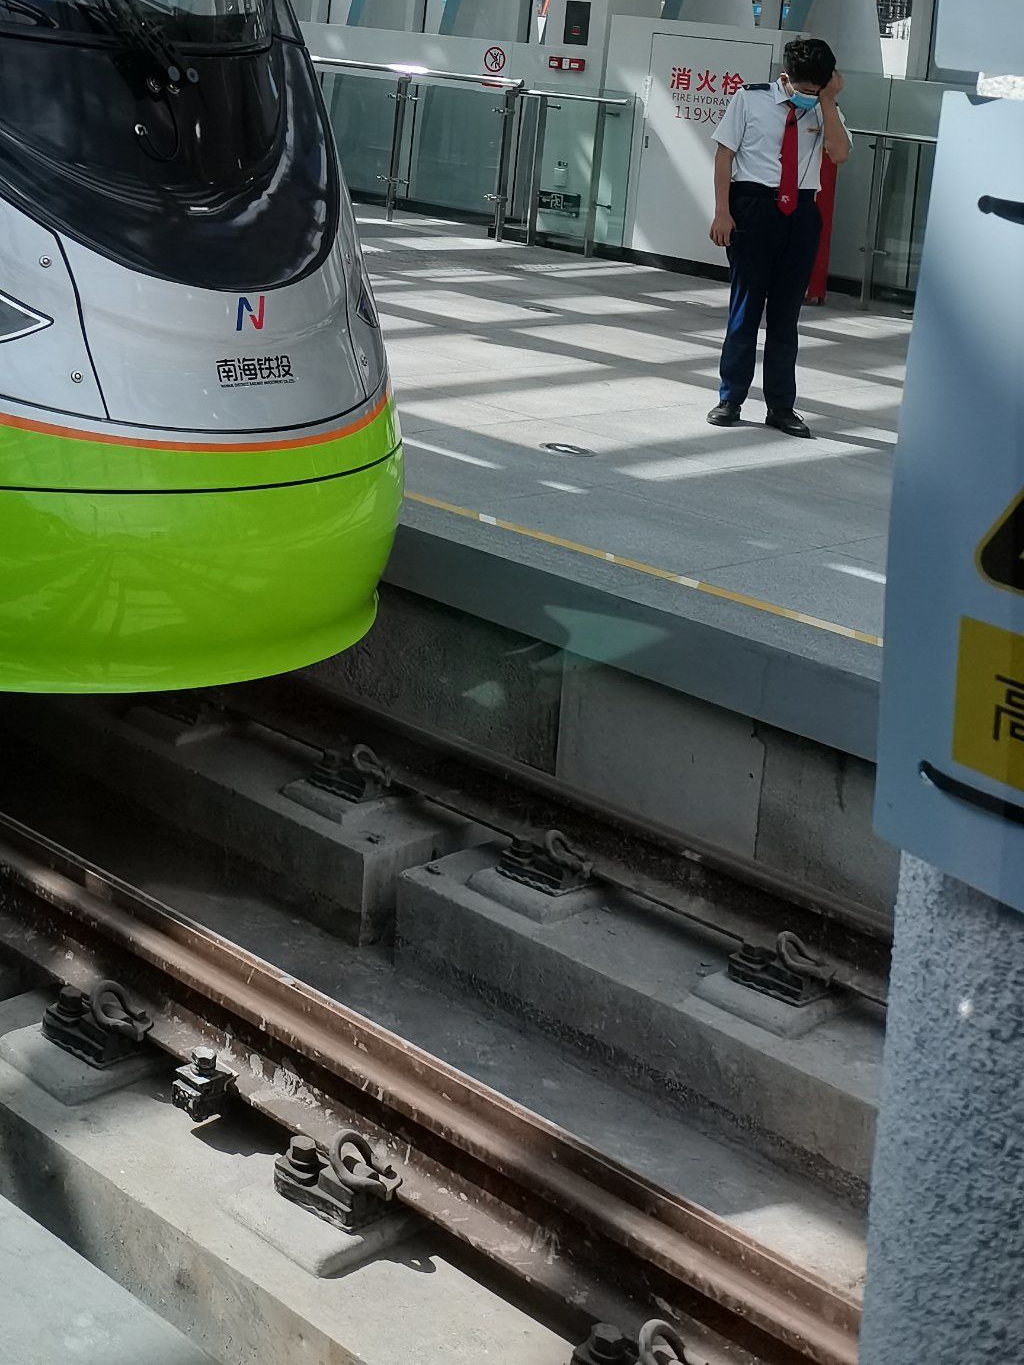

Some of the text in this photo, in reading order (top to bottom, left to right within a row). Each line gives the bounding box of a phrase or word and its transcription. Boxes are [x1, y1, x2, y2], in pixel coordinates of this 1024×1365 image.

[670, 67, 745, 96] 消火栓
[672, 92, 731, 107] FIRE HYDRAN
[215, 355, 294, 383] 南海铁投
